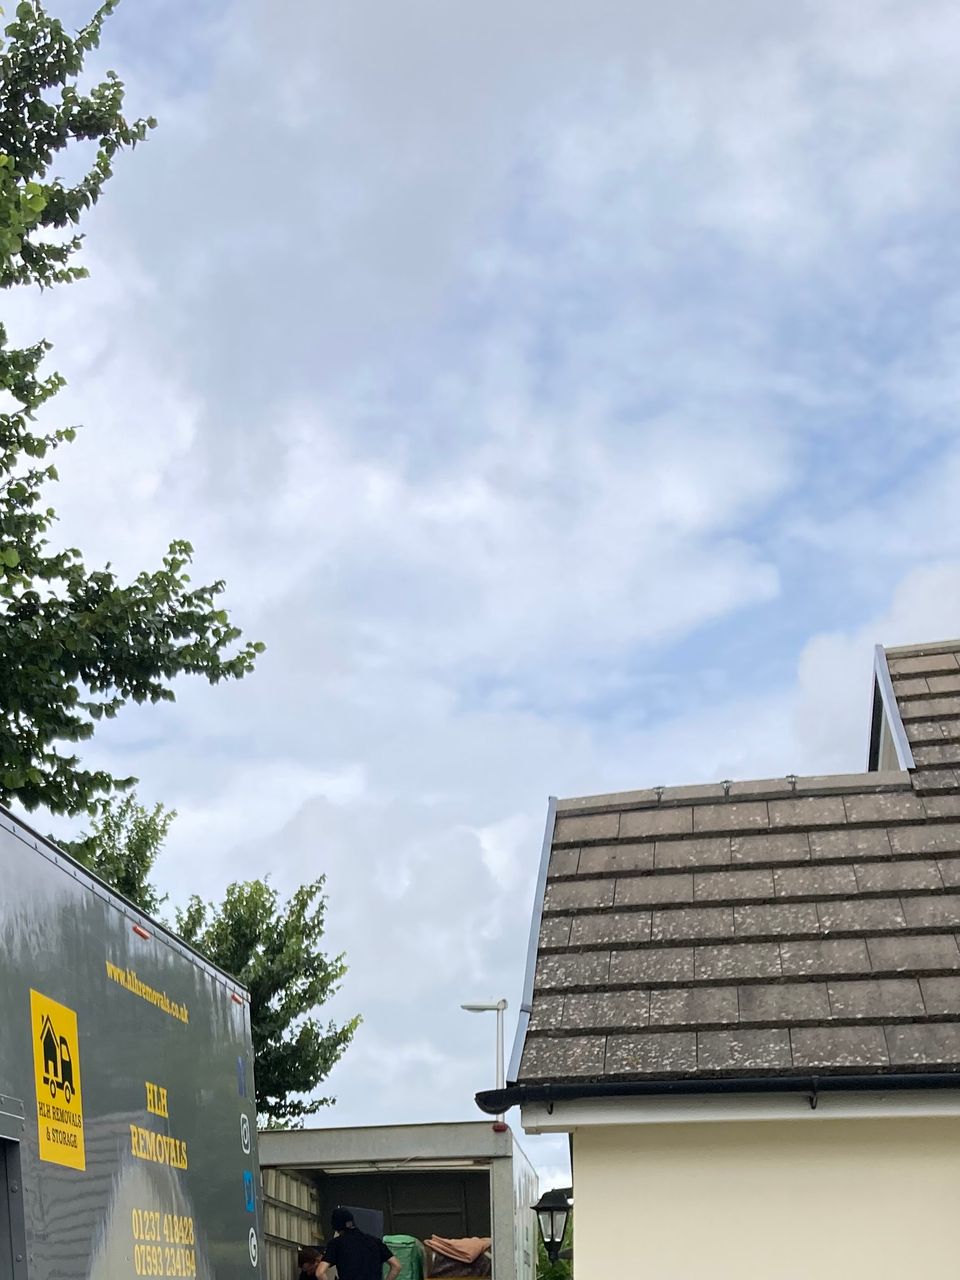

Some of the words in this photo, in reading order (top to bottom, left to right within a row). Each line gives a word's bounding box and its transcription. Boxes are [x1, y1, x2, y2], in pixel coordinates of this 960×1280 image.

[38, 1101, 51, 1118] HLH
[52, 1106, 82, 1129] REMOVALS
[145, 1081, 169, 1119] HLH
[51, 1127, 78, 1149] STORAGE
[129, 1123, 188, 1170] REMOVALS
[132, 1207, 161, 1242] 01237
[135, 1243, 163, 1277] 07593
[165, 1246, 197, 1278] 234194
